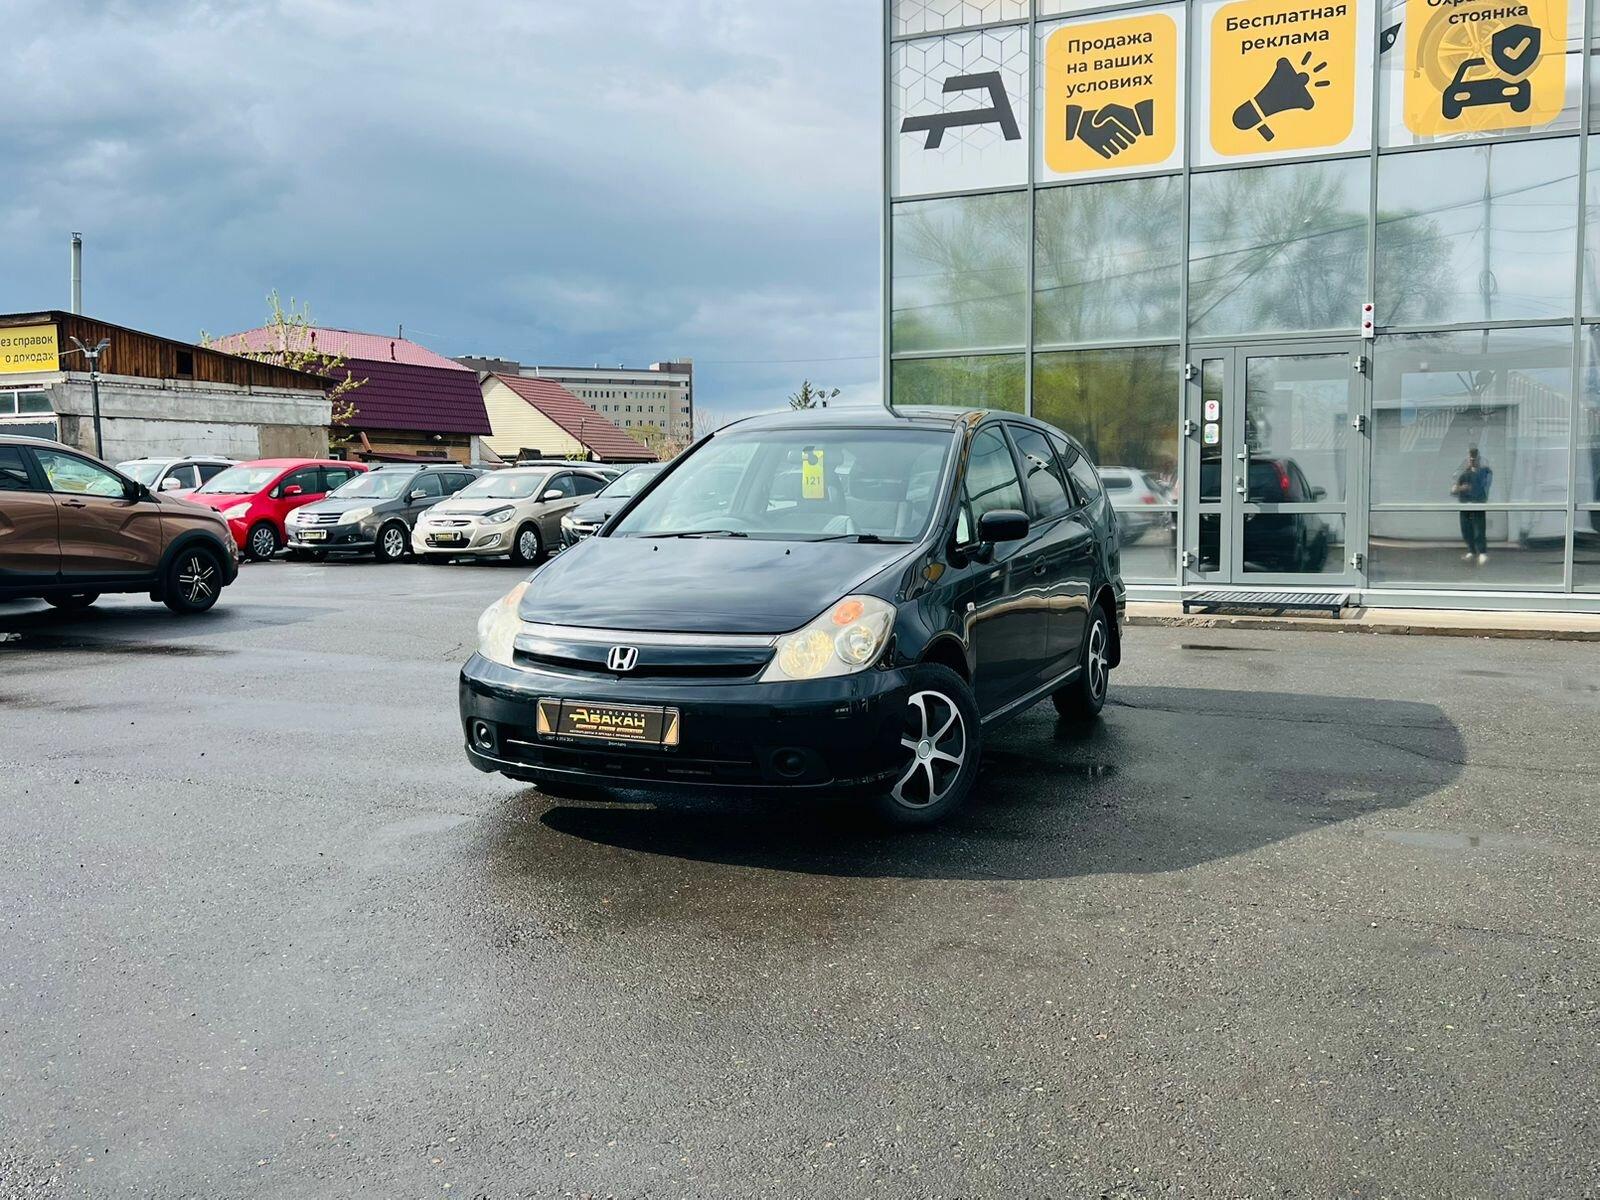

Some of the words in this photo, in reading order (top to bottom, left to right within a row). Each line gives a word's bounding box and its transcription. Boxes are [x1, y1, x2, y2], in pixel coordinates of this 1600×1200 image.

[1226, 5, 1346, 31] Бесплатная
[1448, 5, 1528, 24] стоянка
[1068, 31, 1152, 54] Продажа
[1241, 29, 1329, 54] реклама
[1067, 62, 1087, 74] на
[1093, 53, 1153, 70] ваших
[1066, 74, 1152, 98] условиях
[0, 338, 11, 347] ез
[13, 336, 53, 348] справок
[5, 354, 11, 363] о
[13, 352, 54, 364] доходах
[805, 476, 820, 485] 121
[569, 708, 645, 727] АБАКАН
